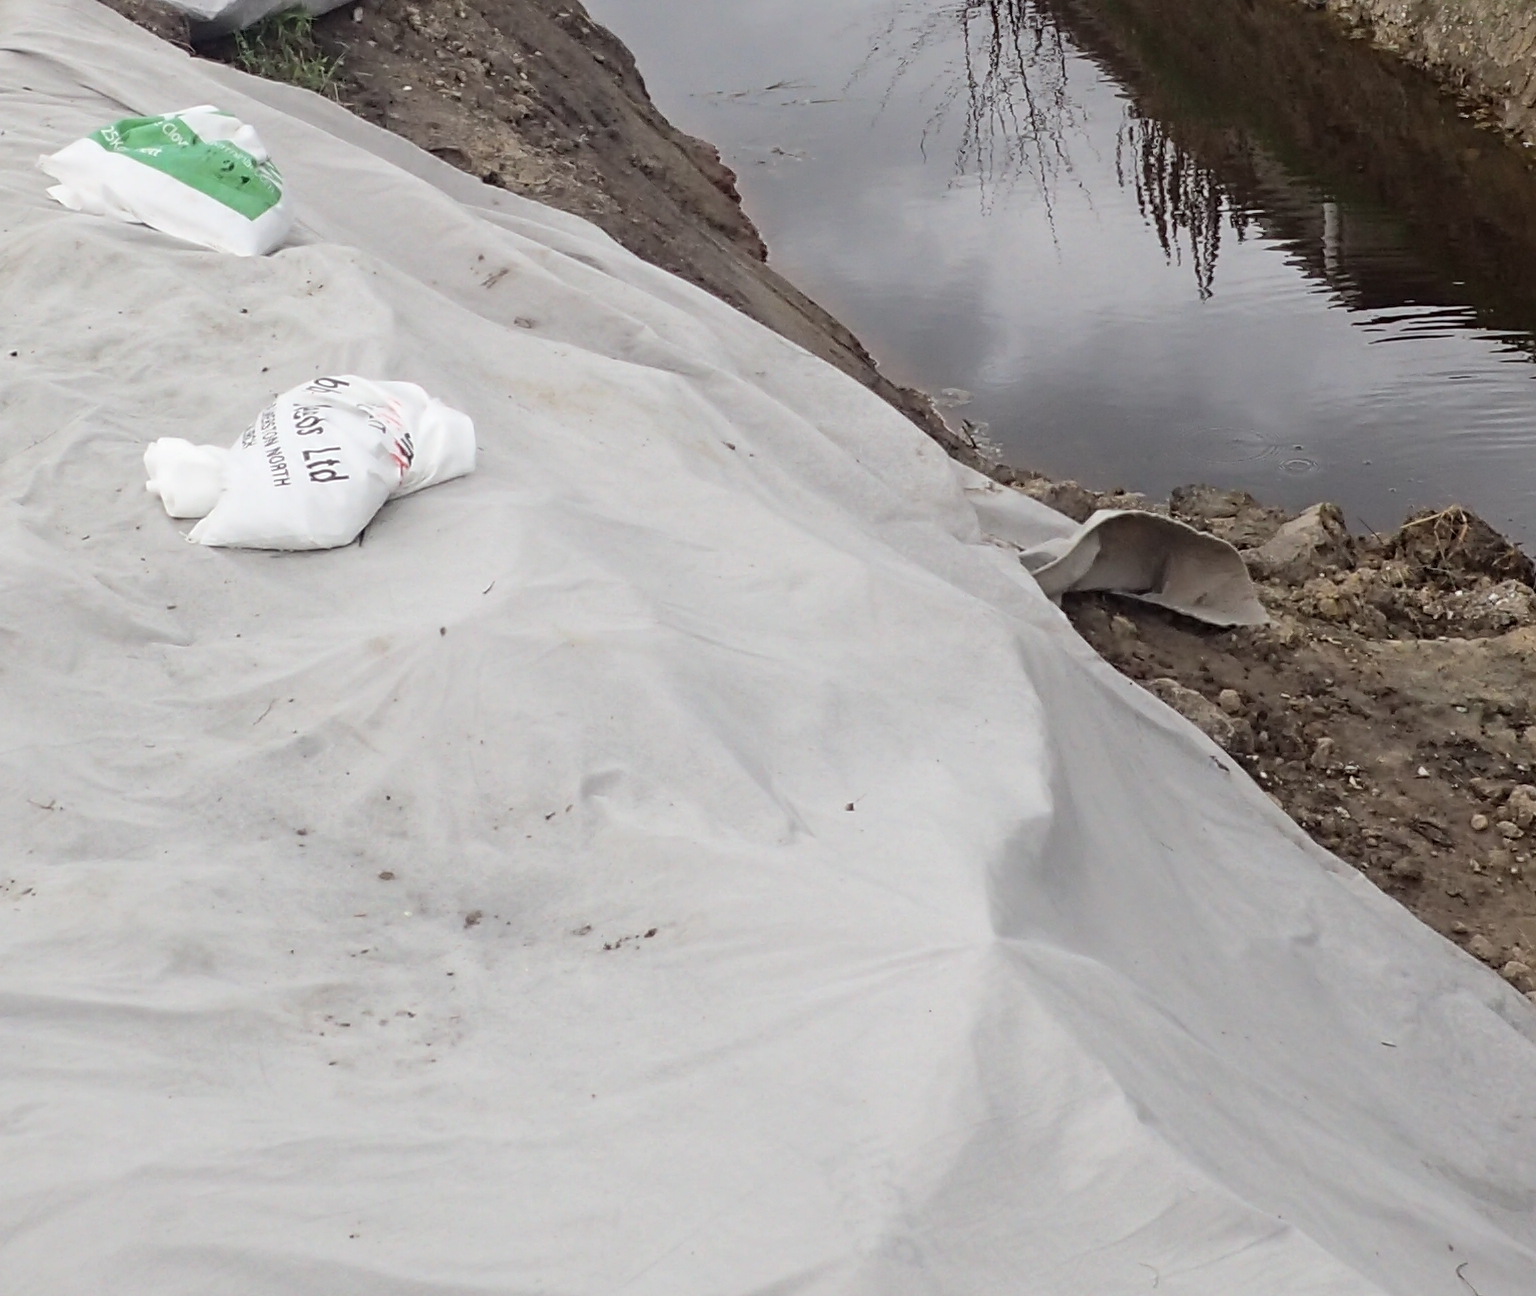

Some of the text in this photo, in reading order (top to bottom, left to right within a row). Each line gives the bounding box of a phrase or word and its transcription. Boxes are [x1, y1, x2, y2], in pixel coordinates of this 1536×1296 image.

[162, 122, 190, 146] Clov
[265, 446, 292, 487] NORTH
[302, 446, 350, 482] Ltd
